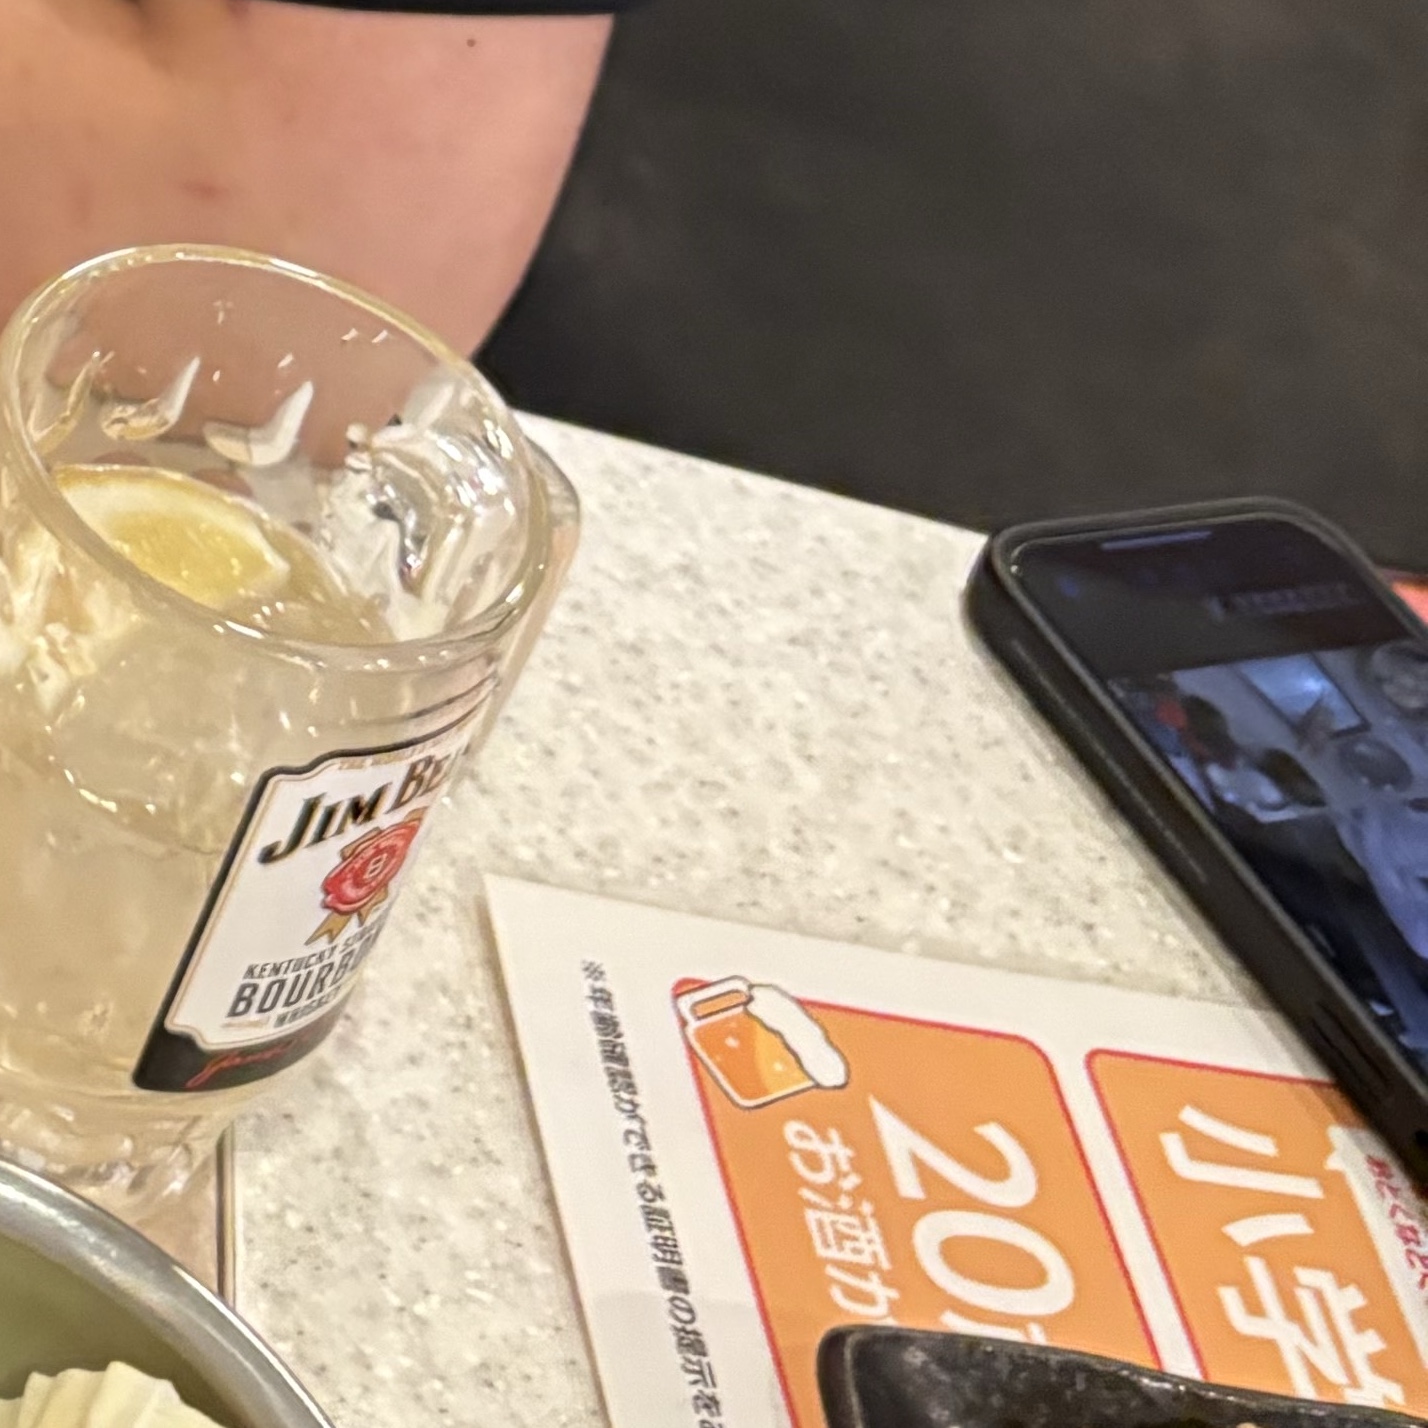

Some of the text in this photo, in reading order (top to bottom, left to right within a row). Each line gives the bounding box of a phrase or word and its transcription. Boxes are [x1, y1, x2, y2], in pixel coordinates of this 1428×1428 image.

[257, 746, 470, 865] JIM BE
[242, 945, 338, 980] KENTUCKY
[868, 1094, 1076, 1346] 20
